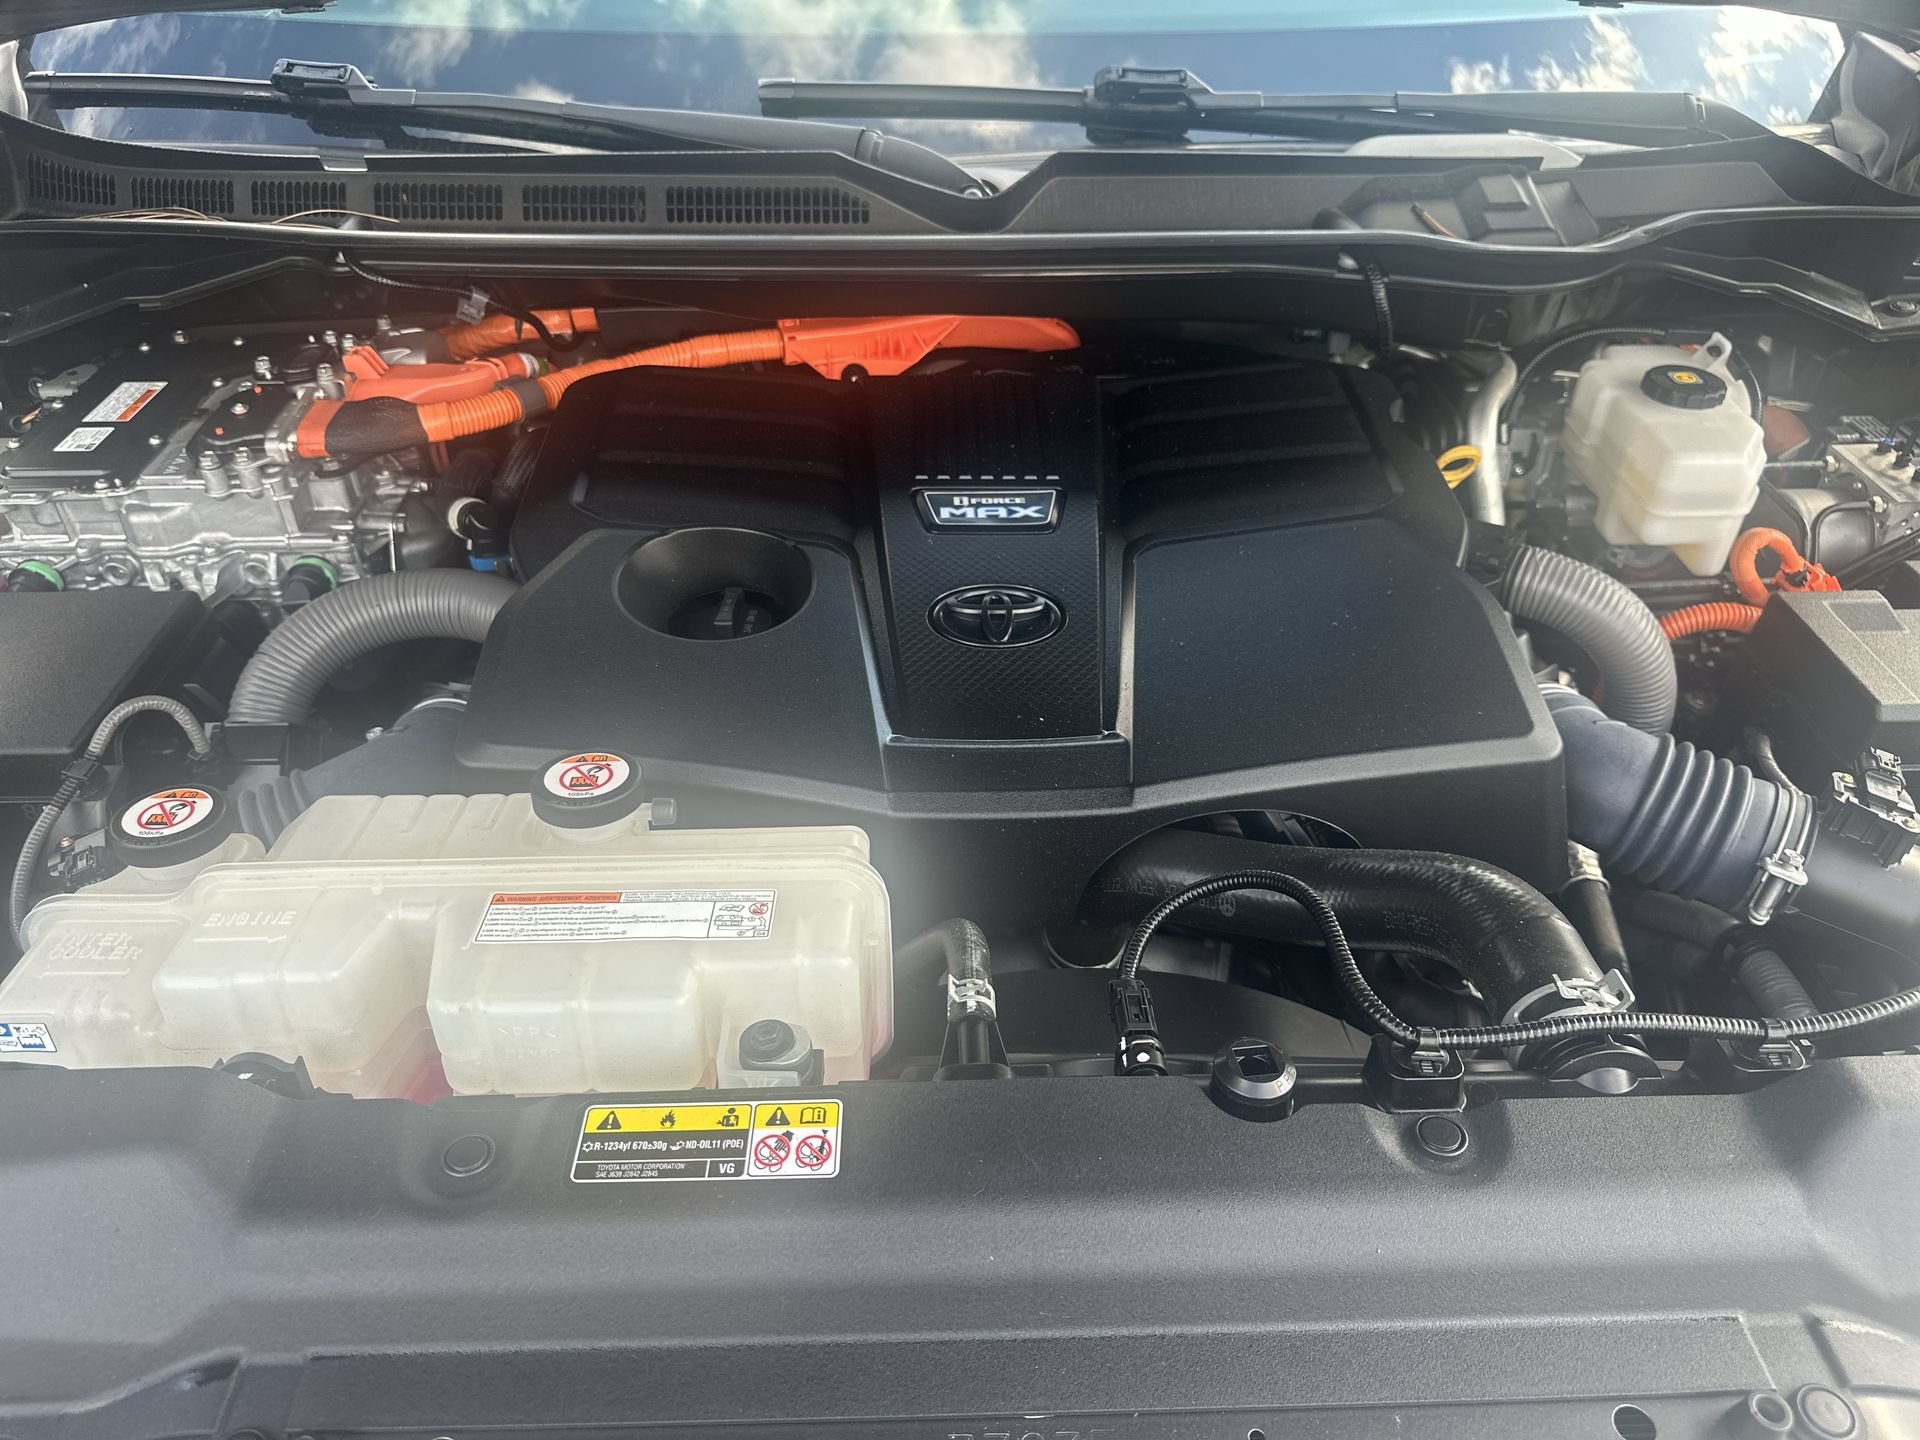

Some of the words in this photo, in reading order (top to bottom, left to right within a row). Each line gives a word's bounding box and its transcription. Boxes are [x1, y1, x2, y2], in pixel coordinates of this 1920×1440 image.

[939, 505, 1046, 519] MAX
[202, 911, 297, 928] ENGINE
[56, 932, 133, 947] INTER
[49, 946, 143, 961] COOLER
[593, 1140, 631, 1152] R-1234yf
[632, 1139, 668, 1152] 670±30g
[685, 1139, 721, 1150] ND-OIL11
[722, 1138, 744, 1150] (POE)
[597, 1163, 619, 1171] TOYOTA
[620, 1163, 642, 1171] MOTOR
[642, 1162, 686, 1170] CORPORATION
[719, 1161, 736, 1175] VG
[622, 1170, 641, 1178] J2842
